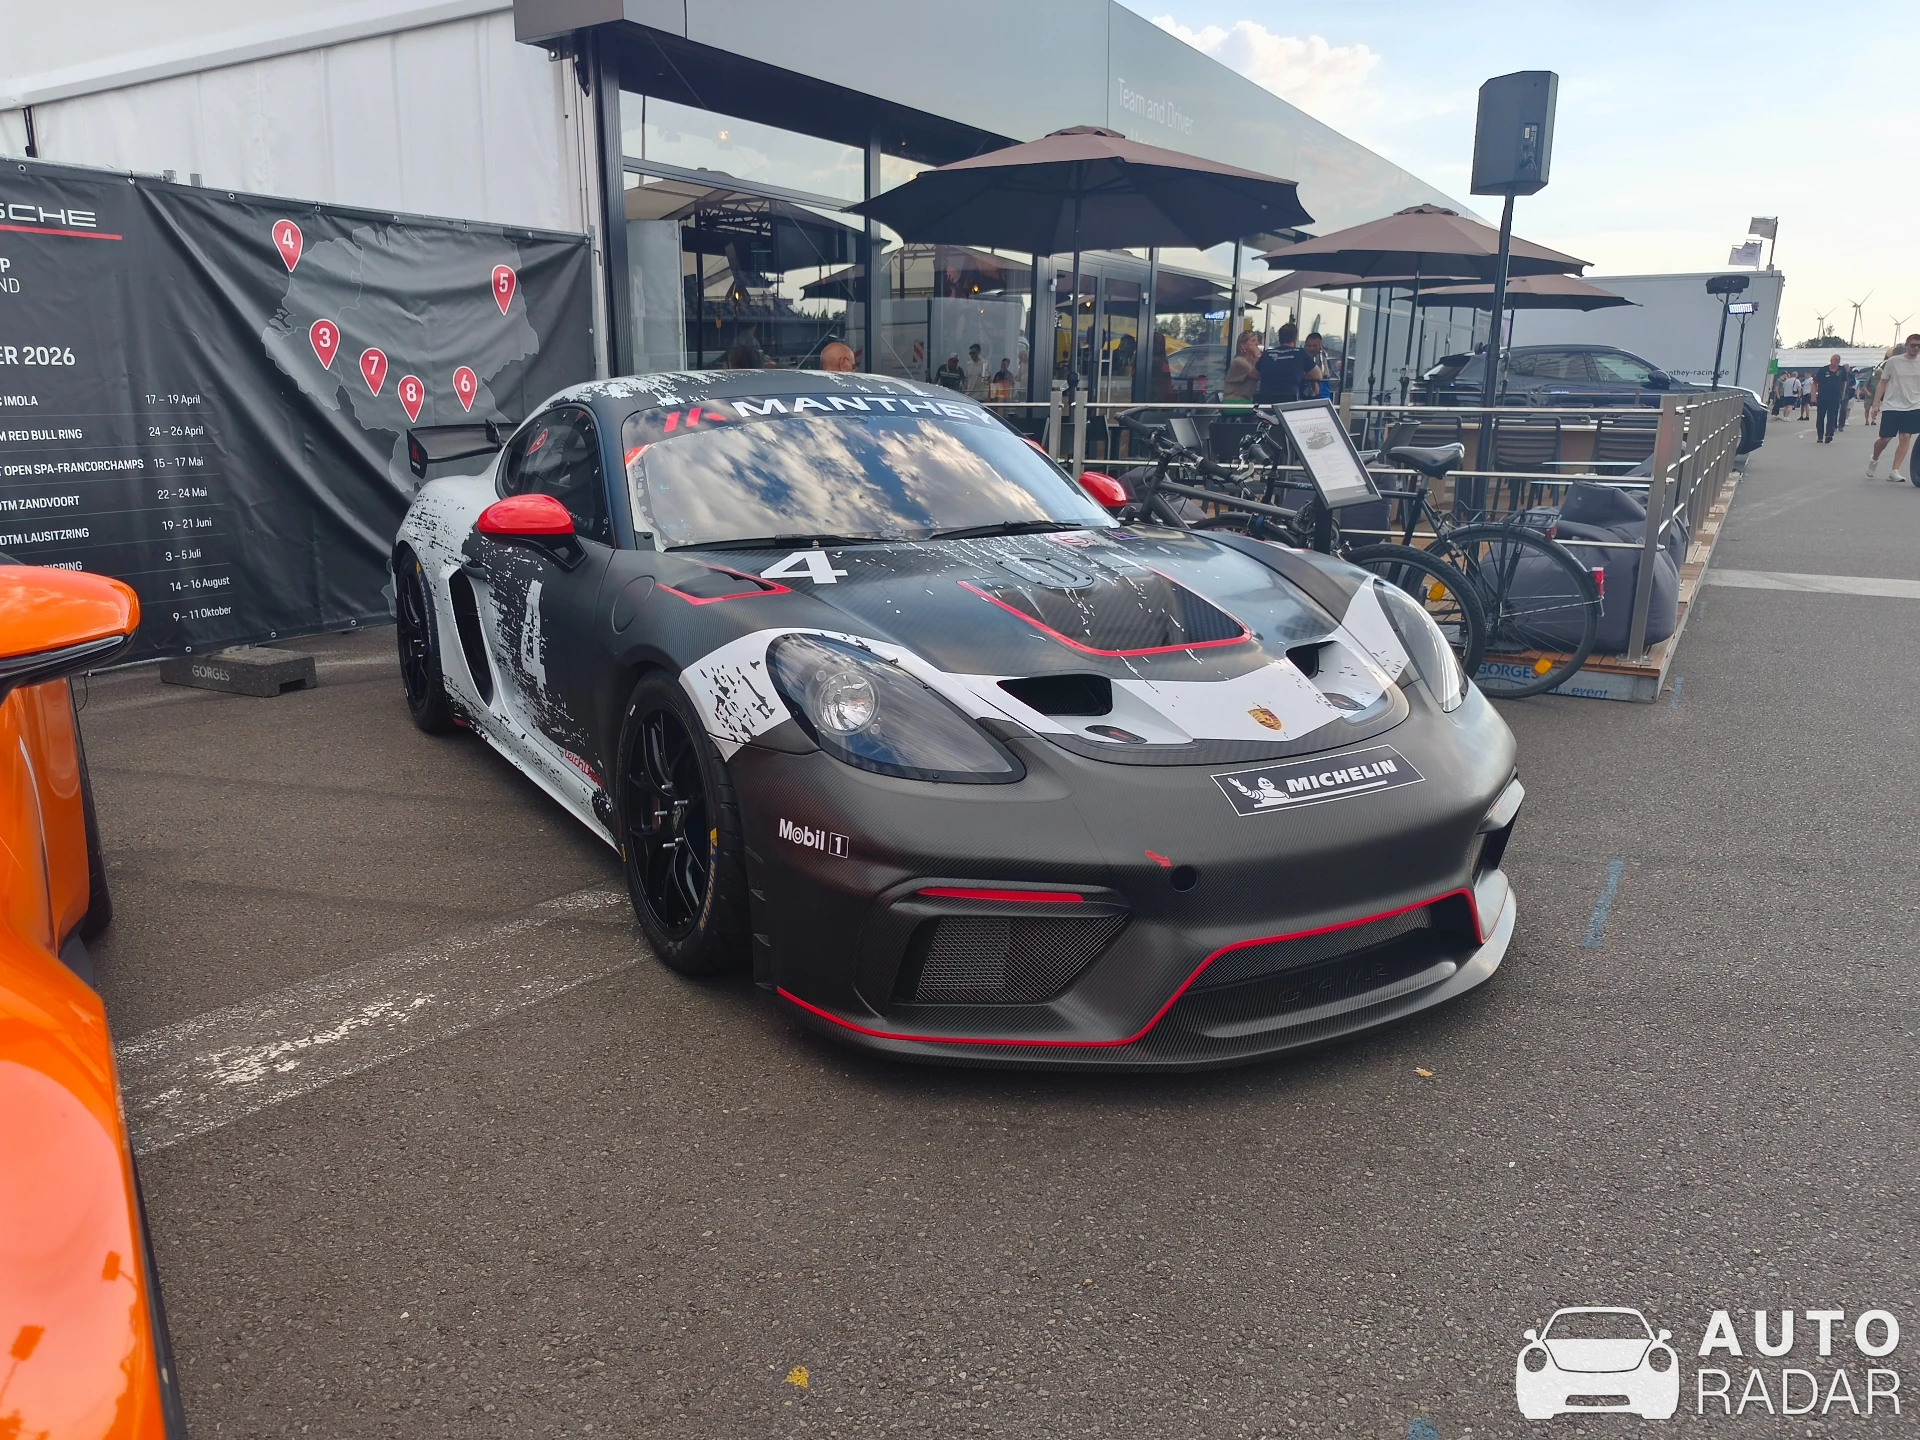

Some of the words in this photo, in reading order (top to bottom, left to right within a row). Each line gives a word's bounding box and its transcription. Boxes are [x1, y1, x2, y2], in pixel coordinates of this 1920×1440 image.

[1118, 77, 1145, 116] Team
[1147, 98, 1165, 124] and
[1167, 101, 1194, 136] Driver
[0, 203, 97, 227] CHE
[282, 228, 294, 249] 4
[498, 273, 509, 293] 5
[319, 331, 331, 348] 3
[22, 346, 76, 366] 2026
[368, 356, 379, 375] 7
[406, 383, 417, 401] 8
[460, 374, 471, 392] 6
[4, 395, 39, 406] IMOLA
[145, 394, 156, 405] 17
[167, 394, 179, 404] 19
[181, 394, 201, 406] April
[731, 397, 993, 425] MANTHEY
[8, 430, 29, 441] RED
[31, 429, 57, 440] BULL
[58, 428, 83, 440] RING
[148, 426, 161, 437] 24
[170, 426, 183, 436] 26
[184, 426, 204, 437] April
[4, 465, 32, 476] OPEN
[34, 459, 145, 475] SPA-FRANCORCHAMPS
[153, 458, 166, 468] 15
[174, 457, 186, 467] 17
[188, 456, 204, 467] Mai
[157, 489, 170, 500] 22
[178, 488, 190, 498] 24
[192, 487, 208, 497] Mai
[0, 500, 17, 511] TM
[19, 495, 80, 510] ZANDVOORT
[162, 520, 174, 531] 19
[182, 518, 193, 529] 21
[195, 517, 212, 528] Juni
[0, 533, 23, 546] DTM
[24, 527, 90, 544] LAUSITZRING
[165, 551, 172, 562] 3
[181, 549, 187, 560] 5
[188, 548, 202, 559] Juli
[760, 550, 849, 584] 4
[169, 581, 182, 592] 14
[190, 578, 201, 589] 16
[202, 576, 230, 589] August
[172, 612, 180, 622] 9
[189, 609, 199, 620] 11
[200, 606, 232, 618] Oktober
[192, 664, 230, 682] GORGES
[1285, 759, 1398, 793] MICHELIN
[779, 818, 825, 851] Mobil
